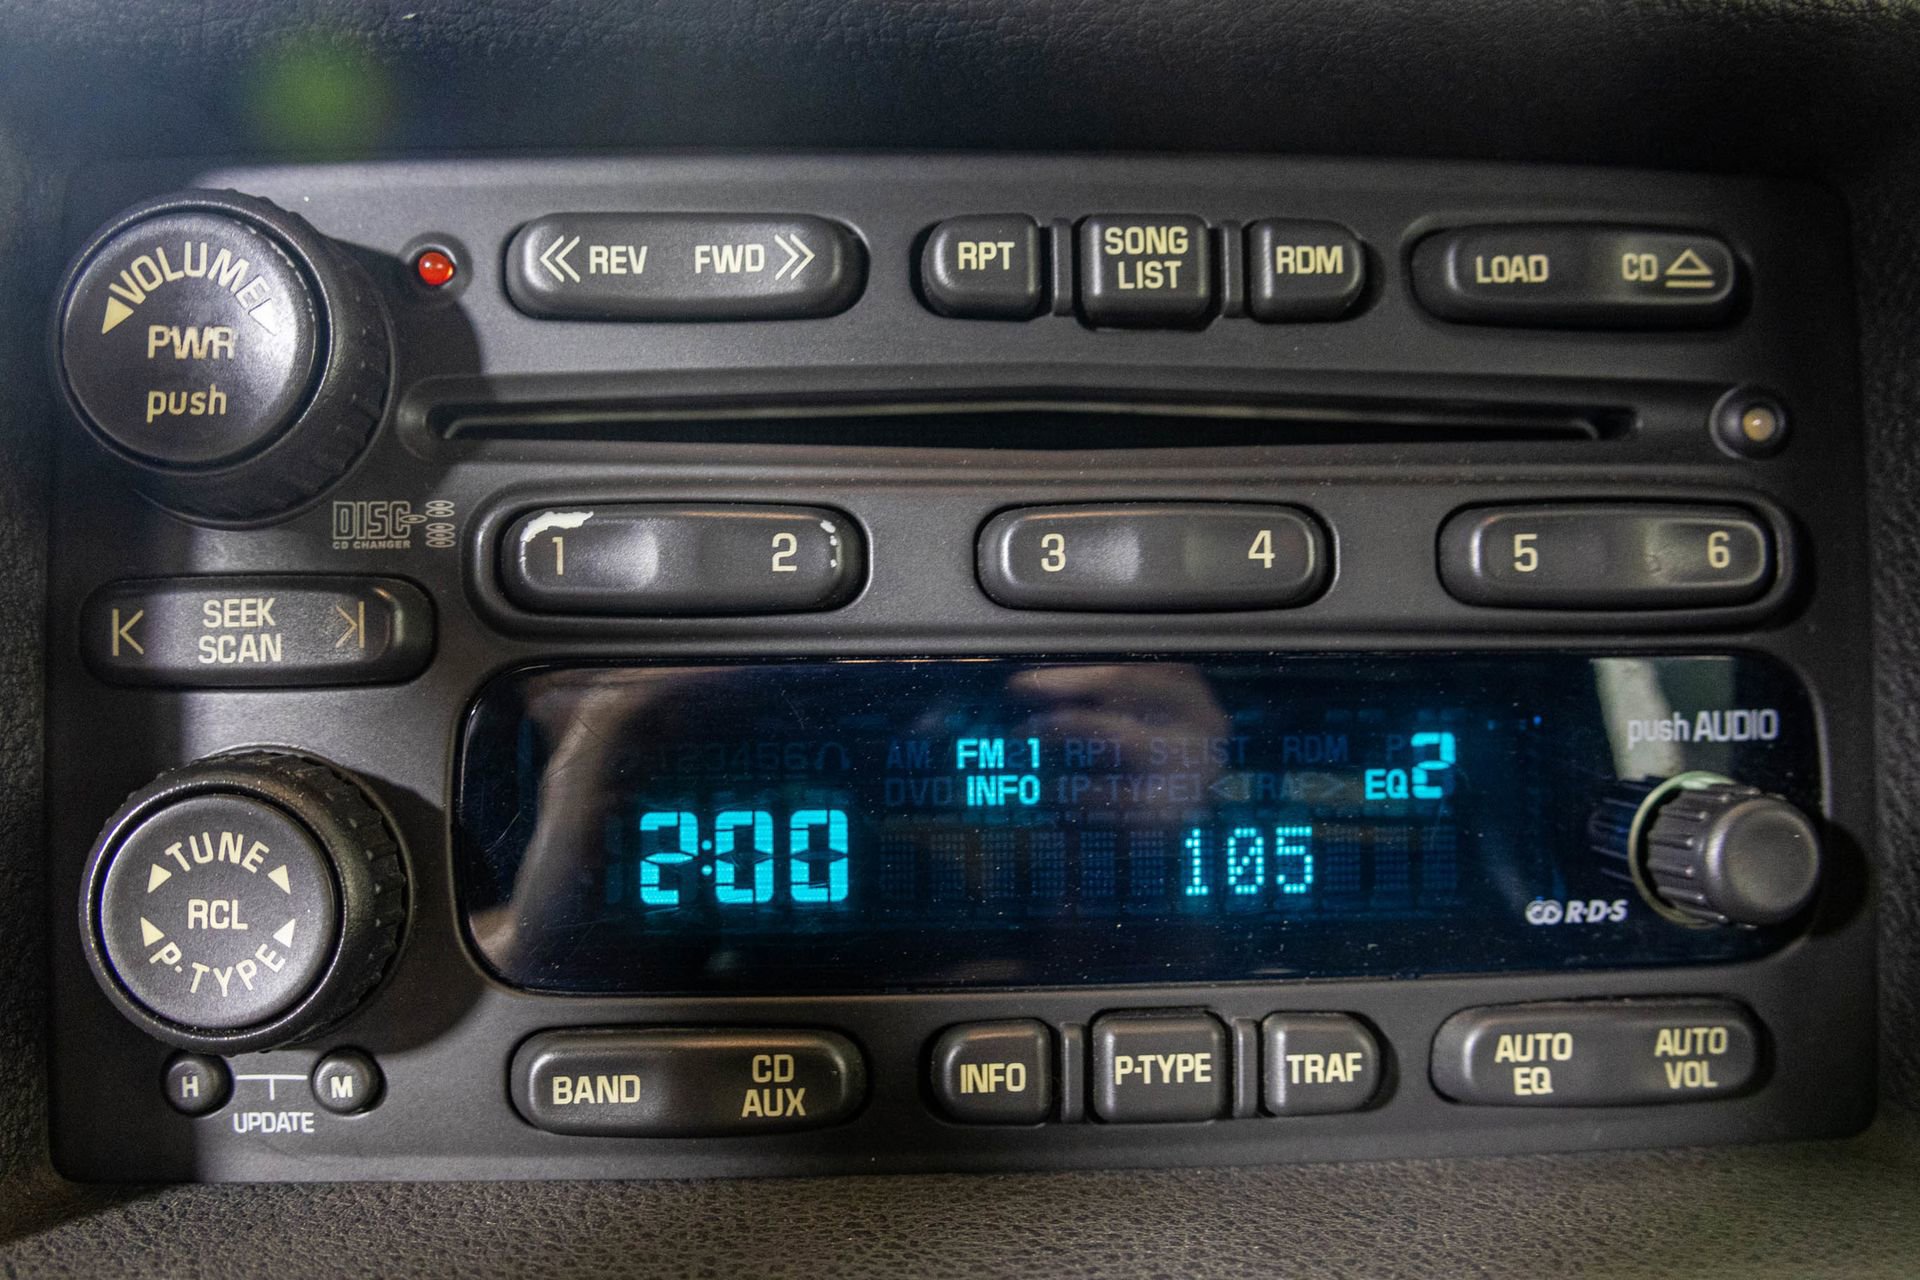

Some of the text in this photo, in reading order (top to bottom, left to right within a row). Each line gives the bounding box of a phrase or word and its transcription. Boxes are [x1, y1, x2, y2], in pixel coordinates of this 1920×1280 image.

[957, 241, 1015, 271] RPT
[1104, 226, 1189, 256] SONG
[109, 241, 271, 306] VOLUME
[589, 245, 648, 275] REV
[694, 244, 765, 274] FWD
[1275, 245, 1344, 275] RDM
[1475, 254, 1549, 284] LOAD
[1621, 253, 1659, 282] CD
[1117, 260, 1182, 290] LIST
[147, 325, 235, 360] PWR
[146, 384, 227, 424] push
[333, 540, 411, 550] CD CHANGER
[552, 536, 564, 576] 1
[771, 532, 798, 572] 2
[1040, 533, 1067, 572] 3
[1247, 529, 1276, 569] 4
[1513, 533, 1539, 572] 5
[1707, 531, 1730, 568] 6
[203, 597, 276, 629] SEEK
[198, 632, 282, 664] SCAN
[1627, 708, 1778, 750] push AUDIO
[1364, 768, 1409, 800] EQ
[1411, 732, 1455, 799] 2
[966, 775, 1041, 806] INFO
[165, 831, 270, 874] TUNE
[640, 810, 848, 905] 2:00
[1185, 826, 1314, 896] 105
[187, 899, 248, 930] RCL
[1494, 1032, 1573, 1063] AUTO
[1654, 1027, 1727, 1057] AUTO
[752, 1054, 795, 1083] CD
[960, 1063, 1026, 1093] INFO
[1115, 1053, 1212, 1085] P-TYPE
[1286, 1052, 1363, 1084] TRAF
[1513, 1067, 1554, 1095] EQ
[1665, 1060, 1718, 1089] VOL
[181, 1076, 199, 1099] H
[331, 1075, 353, 1099] M
[552, 1075, 641, 1105] BAND
[741, 1088, 807, 1118] AUX
[233, 1111, 316, 1134] UPDATE
